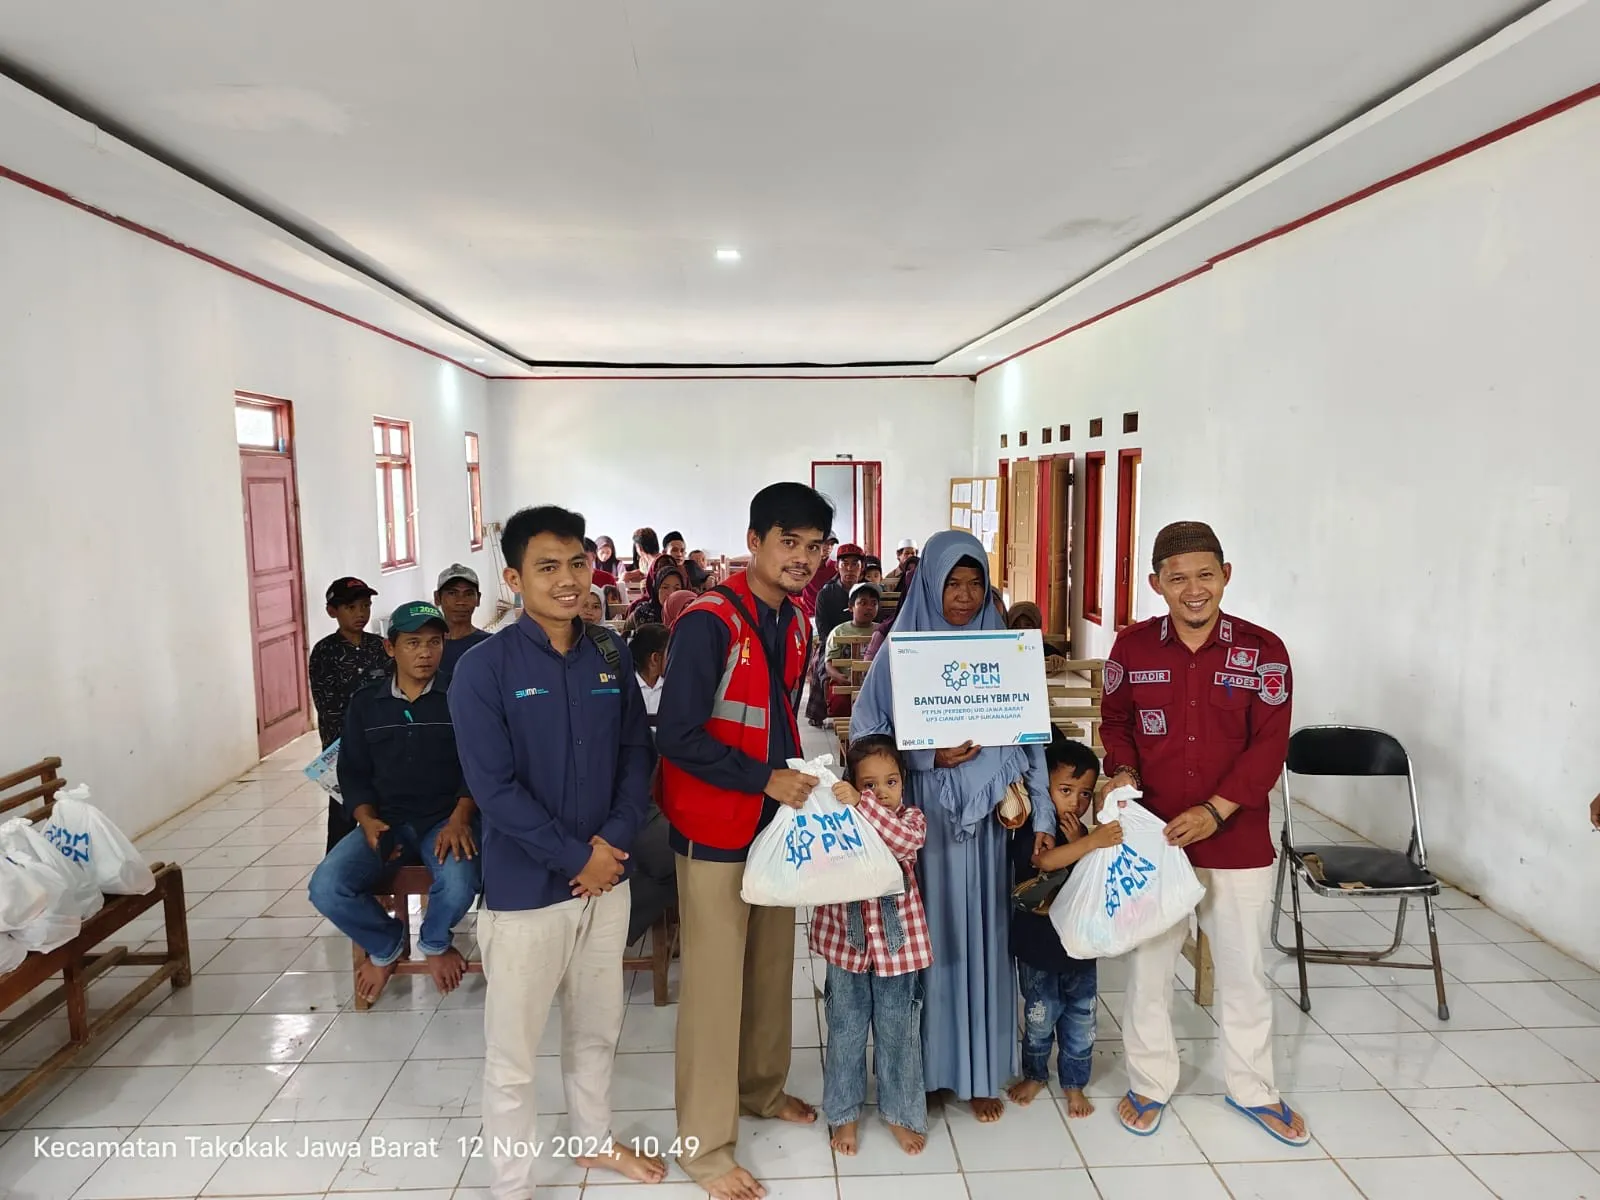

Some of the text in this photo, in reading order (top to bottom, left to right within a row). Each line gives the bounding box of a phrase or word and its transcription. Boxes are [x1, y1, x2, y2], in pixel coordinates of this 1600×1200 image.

[970, 662, 1000, 673] YBM
[973, 674, 1001, 684] PLN
[1135, 672, 1165, 681] NADIR
[1222, 675, 1255, 687] KADES
[914, 693, 1030, 706] BANTUAN OLEH YBM PLN
[811, 807, 854, 831] YBM
[821, 828, 863, 853] PLN
